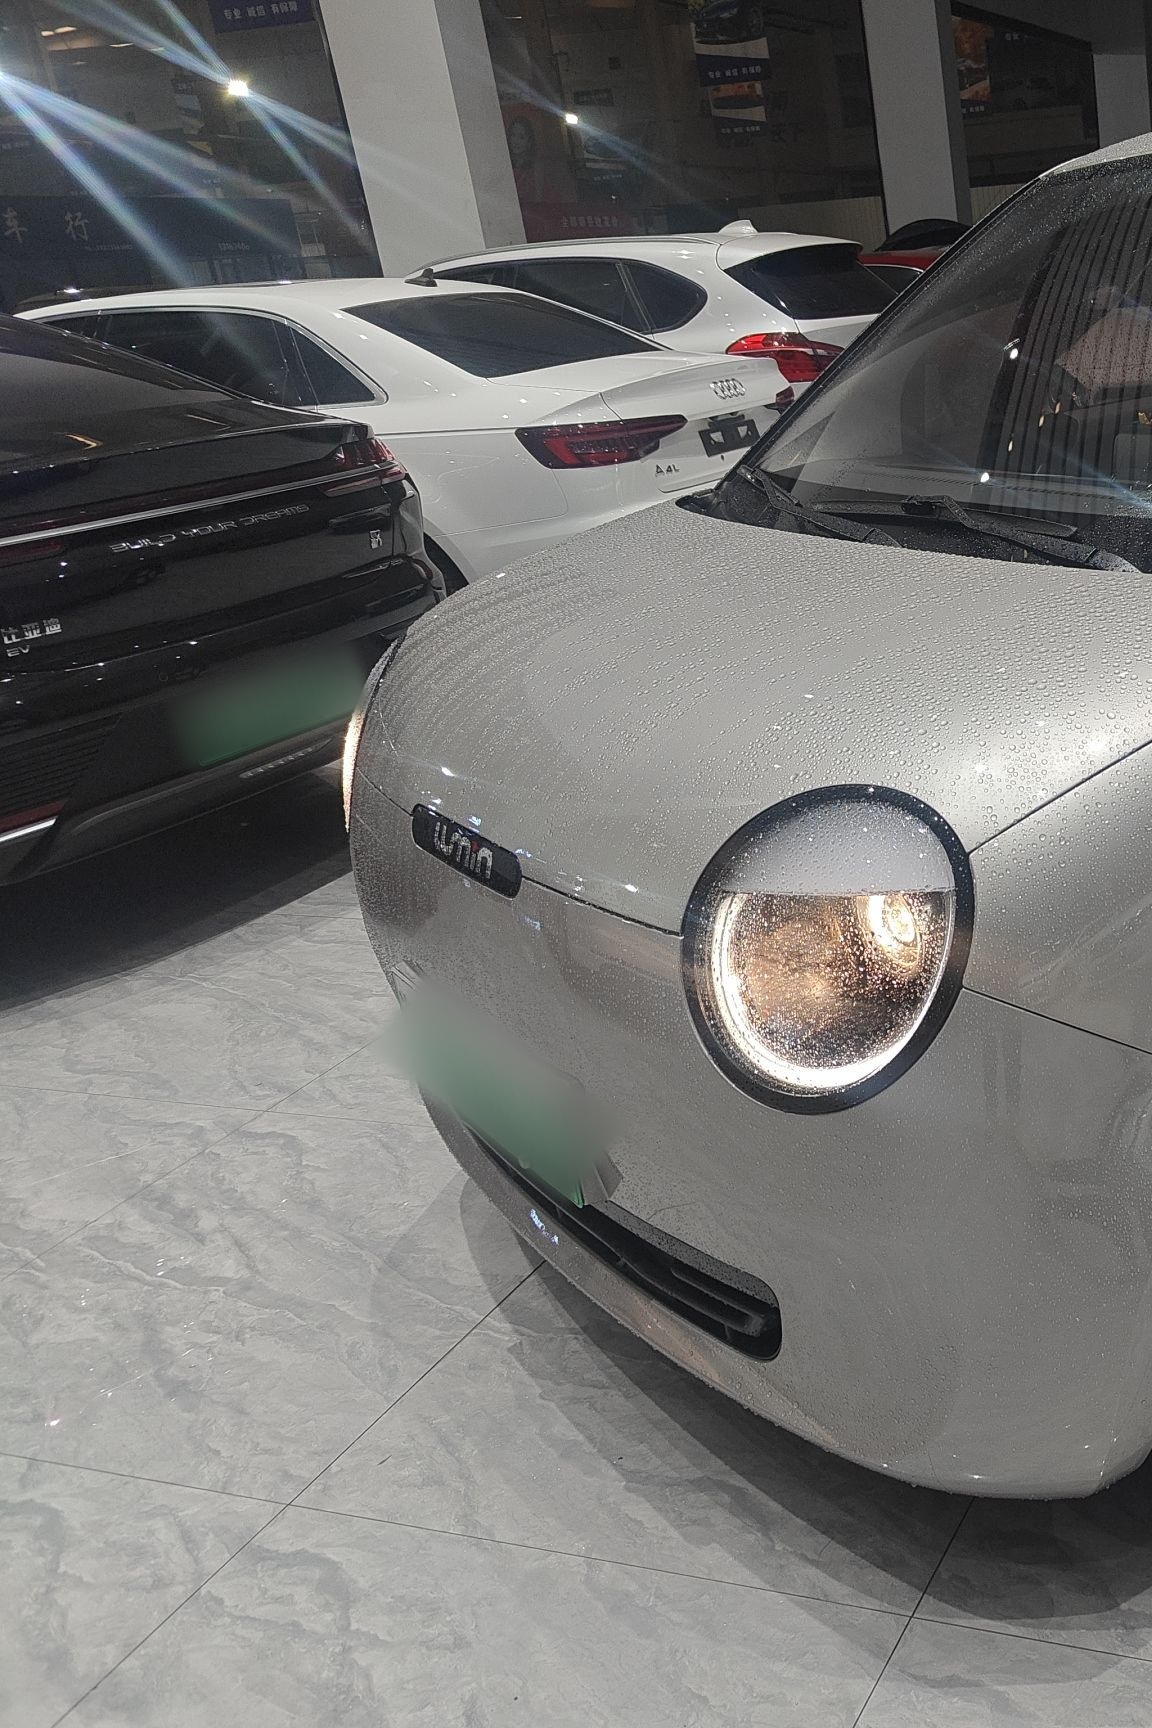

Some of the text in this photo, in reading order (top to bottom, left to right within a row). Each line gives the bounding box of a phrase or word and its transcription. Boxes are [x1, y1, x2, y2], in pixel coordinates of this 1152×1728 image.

[109, 503, 310, 552] BUILD YOUR DREAMS
[0, 618, 62, 644] 比亚迪
[6, 644, 30, 657] EV
